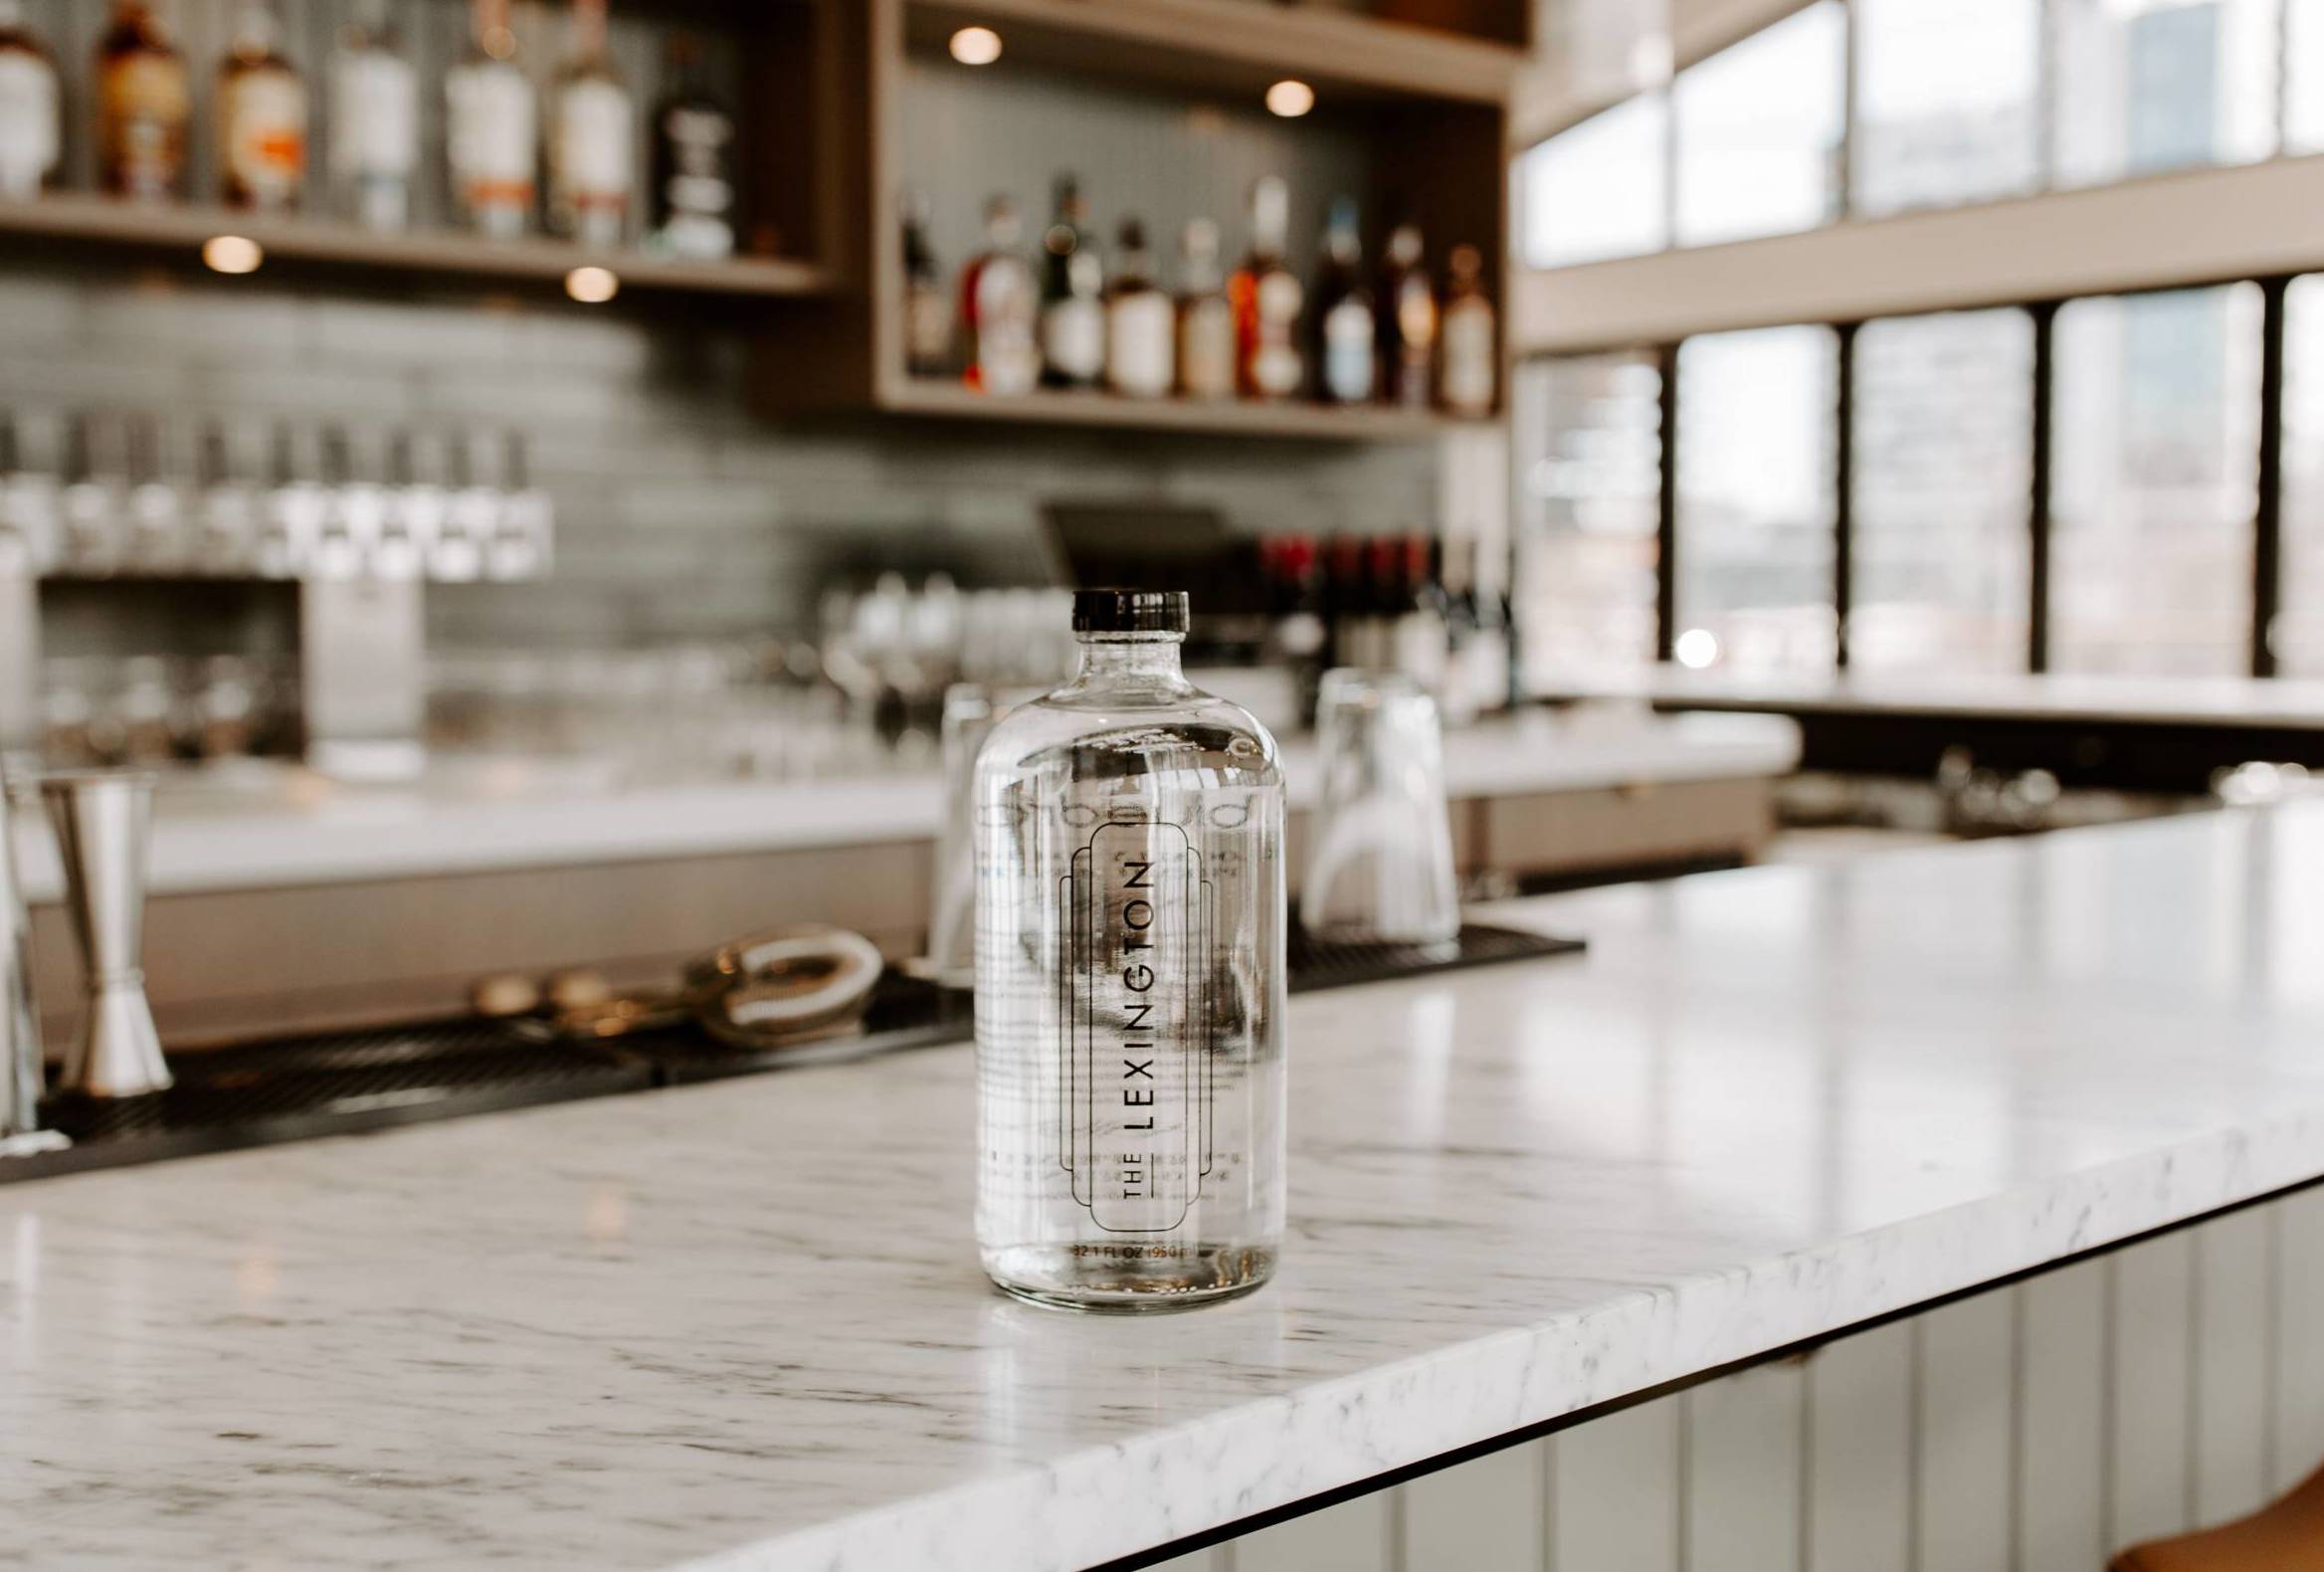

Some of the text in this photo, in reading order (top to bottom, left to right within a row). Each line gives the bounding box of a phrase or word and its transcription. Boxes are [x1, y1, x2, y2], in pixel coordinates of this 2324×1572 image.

[1123, 861, 1154, 1199] THE LEXINGTON
[1072, 1245, 1099, 1258] 321
[1103, 1246, 1116, 1259] FL
[1122, 1246, 1143, 1259] OZ
